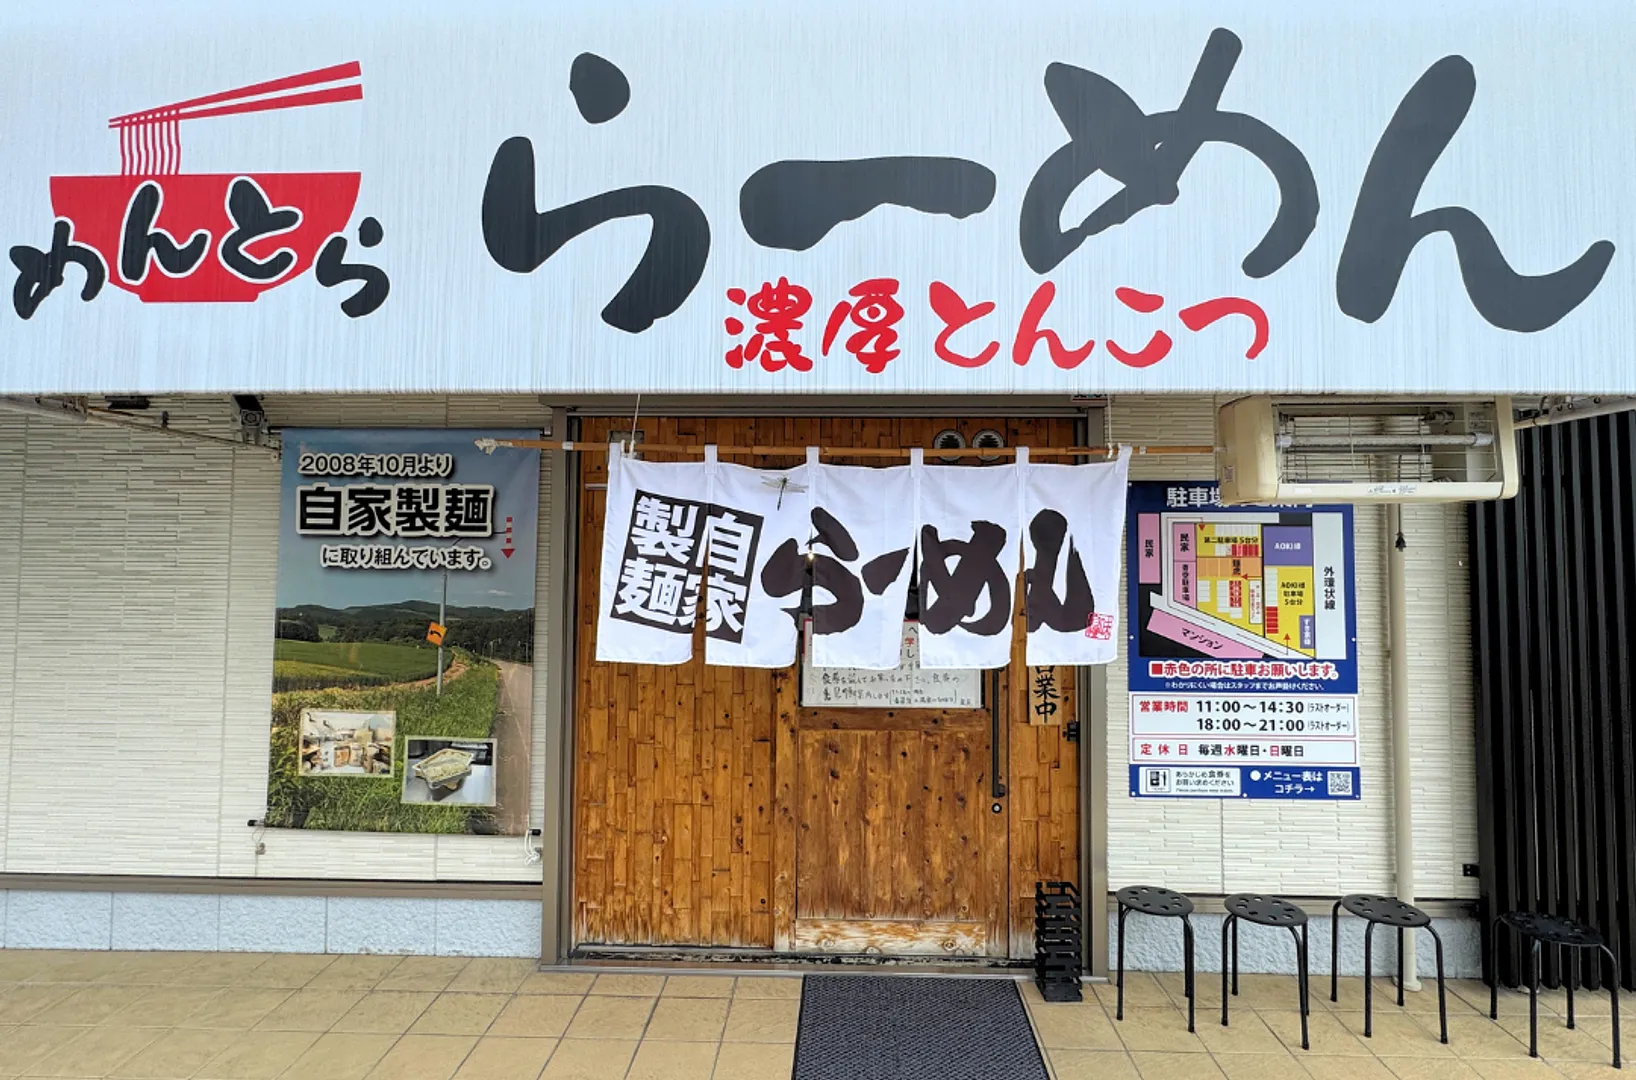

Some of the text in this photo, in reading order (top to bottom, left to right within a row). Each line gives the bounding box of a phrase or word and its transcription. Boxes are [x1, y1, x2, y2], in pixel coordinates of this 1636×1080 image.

[482, 28, 1616, 333] らーめん
[12, 179, 390, 319] めんとら
[725, 276, 1269, 373] 濃厚とんこつ
[299, 454, 453, 476] 2008年10月より
[297, 483, 494, 536] 自家製麺
[321, 546, 492, 569] に取り組んでいます。
[1324, 566, 1336, 610] 外環状線
[1181, 627, 1224, 650] マンション
[1139, 700, 1189, 713] 営業時間
